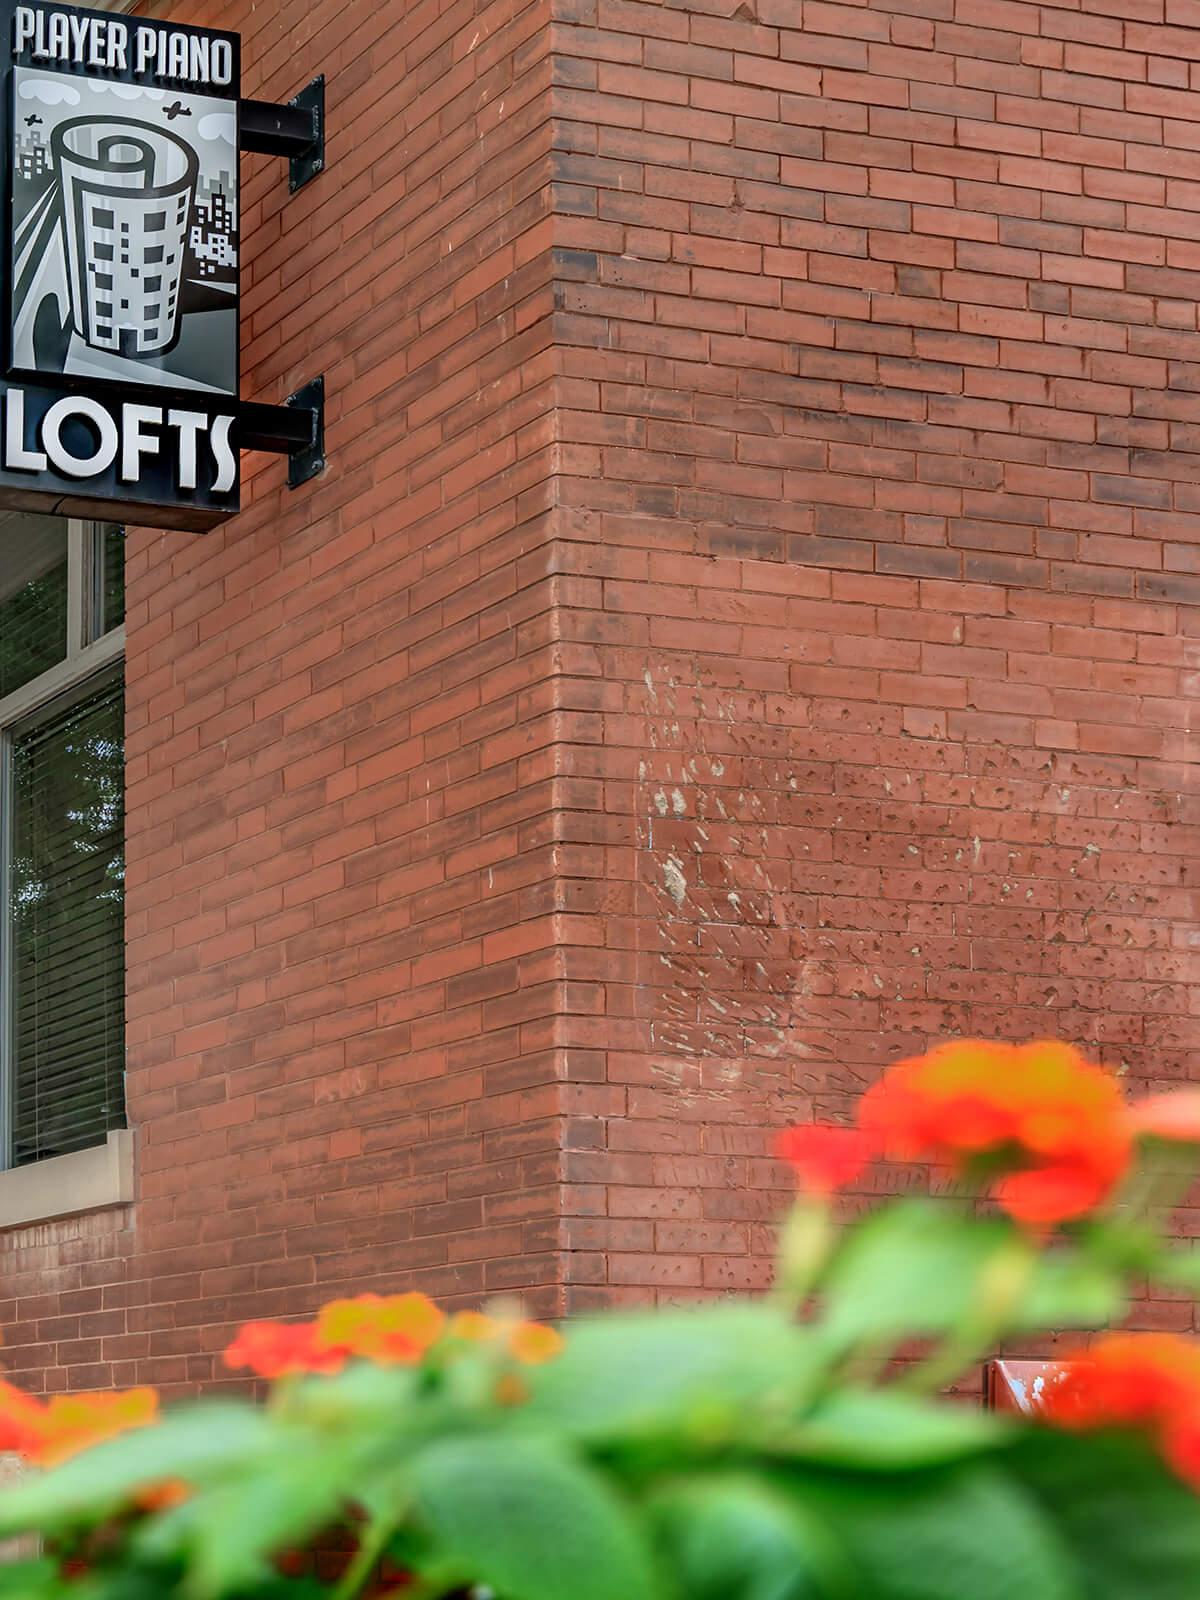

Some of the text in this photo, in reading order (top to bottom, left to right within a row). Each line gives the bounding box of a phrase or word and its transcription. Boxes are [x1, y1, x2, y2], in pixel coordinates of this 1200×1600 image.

[13, 6, 232, 85] PLAYER PIANO
[6, 388, 237, 492] LOFTS
